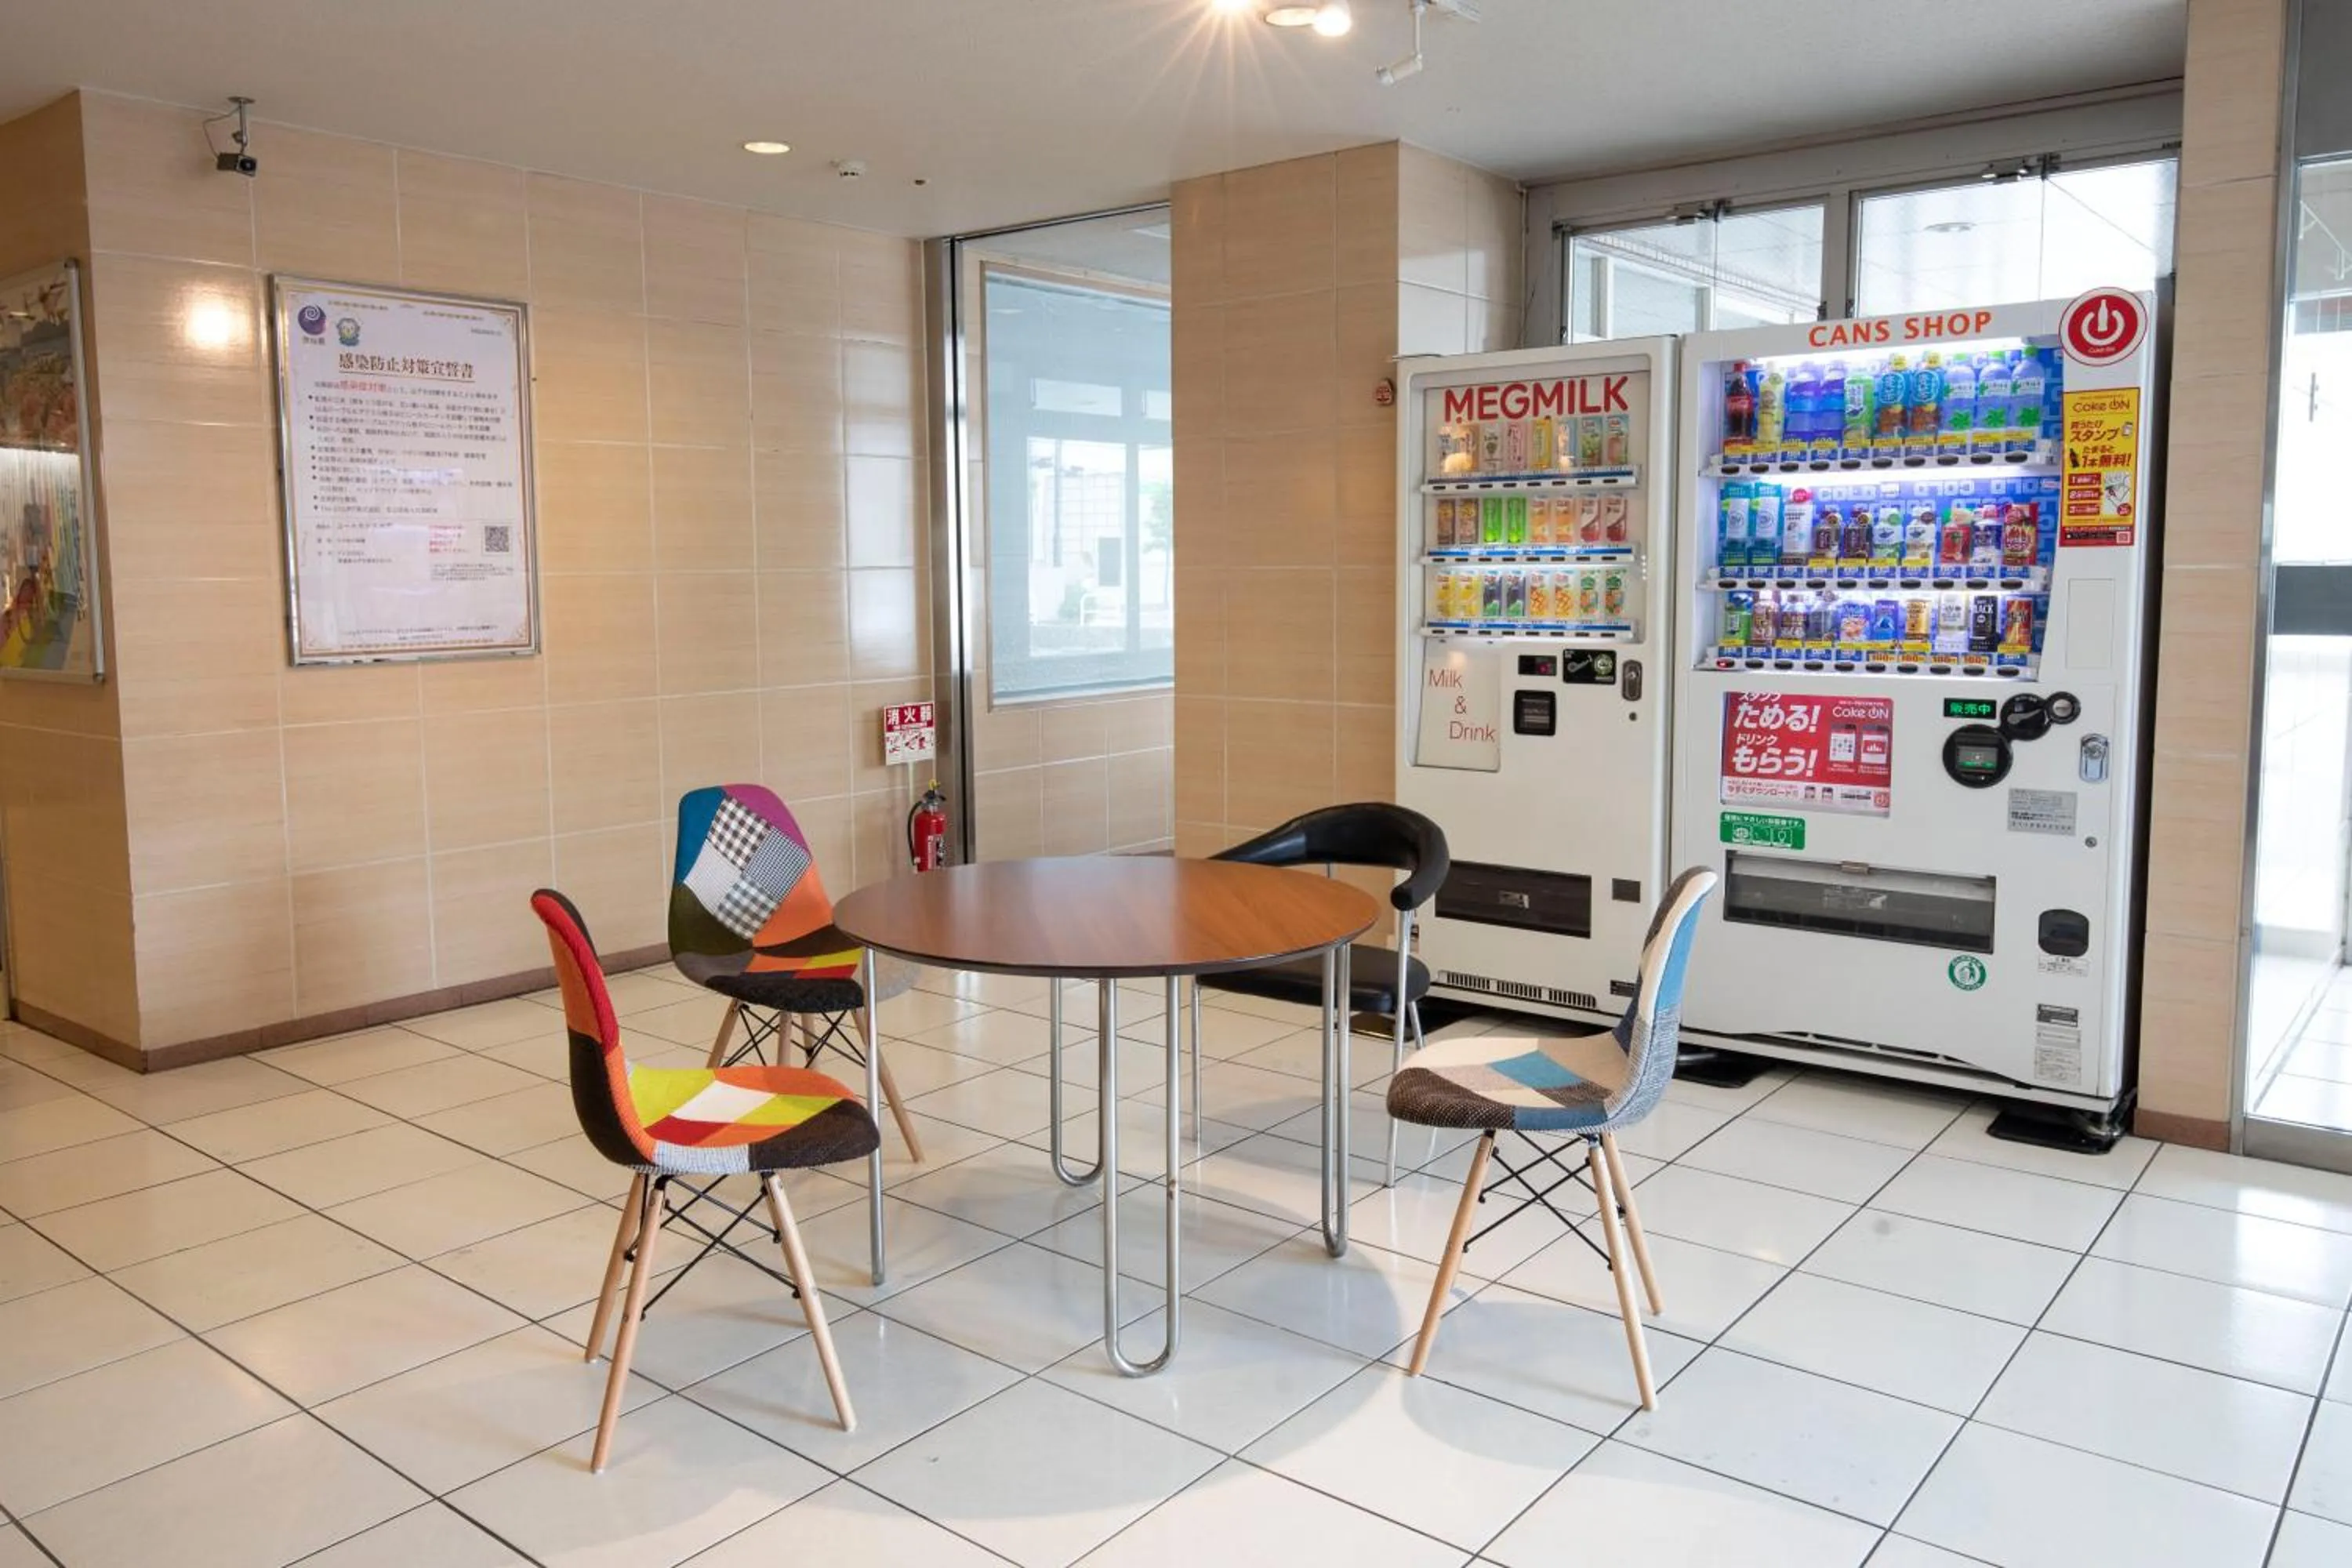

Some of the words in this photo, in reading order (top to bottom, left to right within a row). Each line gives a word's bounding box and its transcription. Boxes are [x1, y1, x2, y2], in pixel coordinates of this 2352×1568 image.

[1808, 319, 1890, 347] CANS
[1904, 311, 1991, 339] SHOP
[1444, 376, 1628, 423] MEGMILK
[2070, 427, 2120, 442] スタンプ
[1428, 669, 1463, 688] Milk
[1454, 696, 1467, 714] &
[1832, 706, 1866, 718] Coke
[1868, 706, 1889, 719] ON
[1950, 702, 1991, 715] 販売中
[1733, 702, 1821, 733] ためる!
[1449, 720, 1497, 743] Drink
[1737, 733, 1778, 746] ドリンク
[1732, 746, 1818, 778] もらう!
